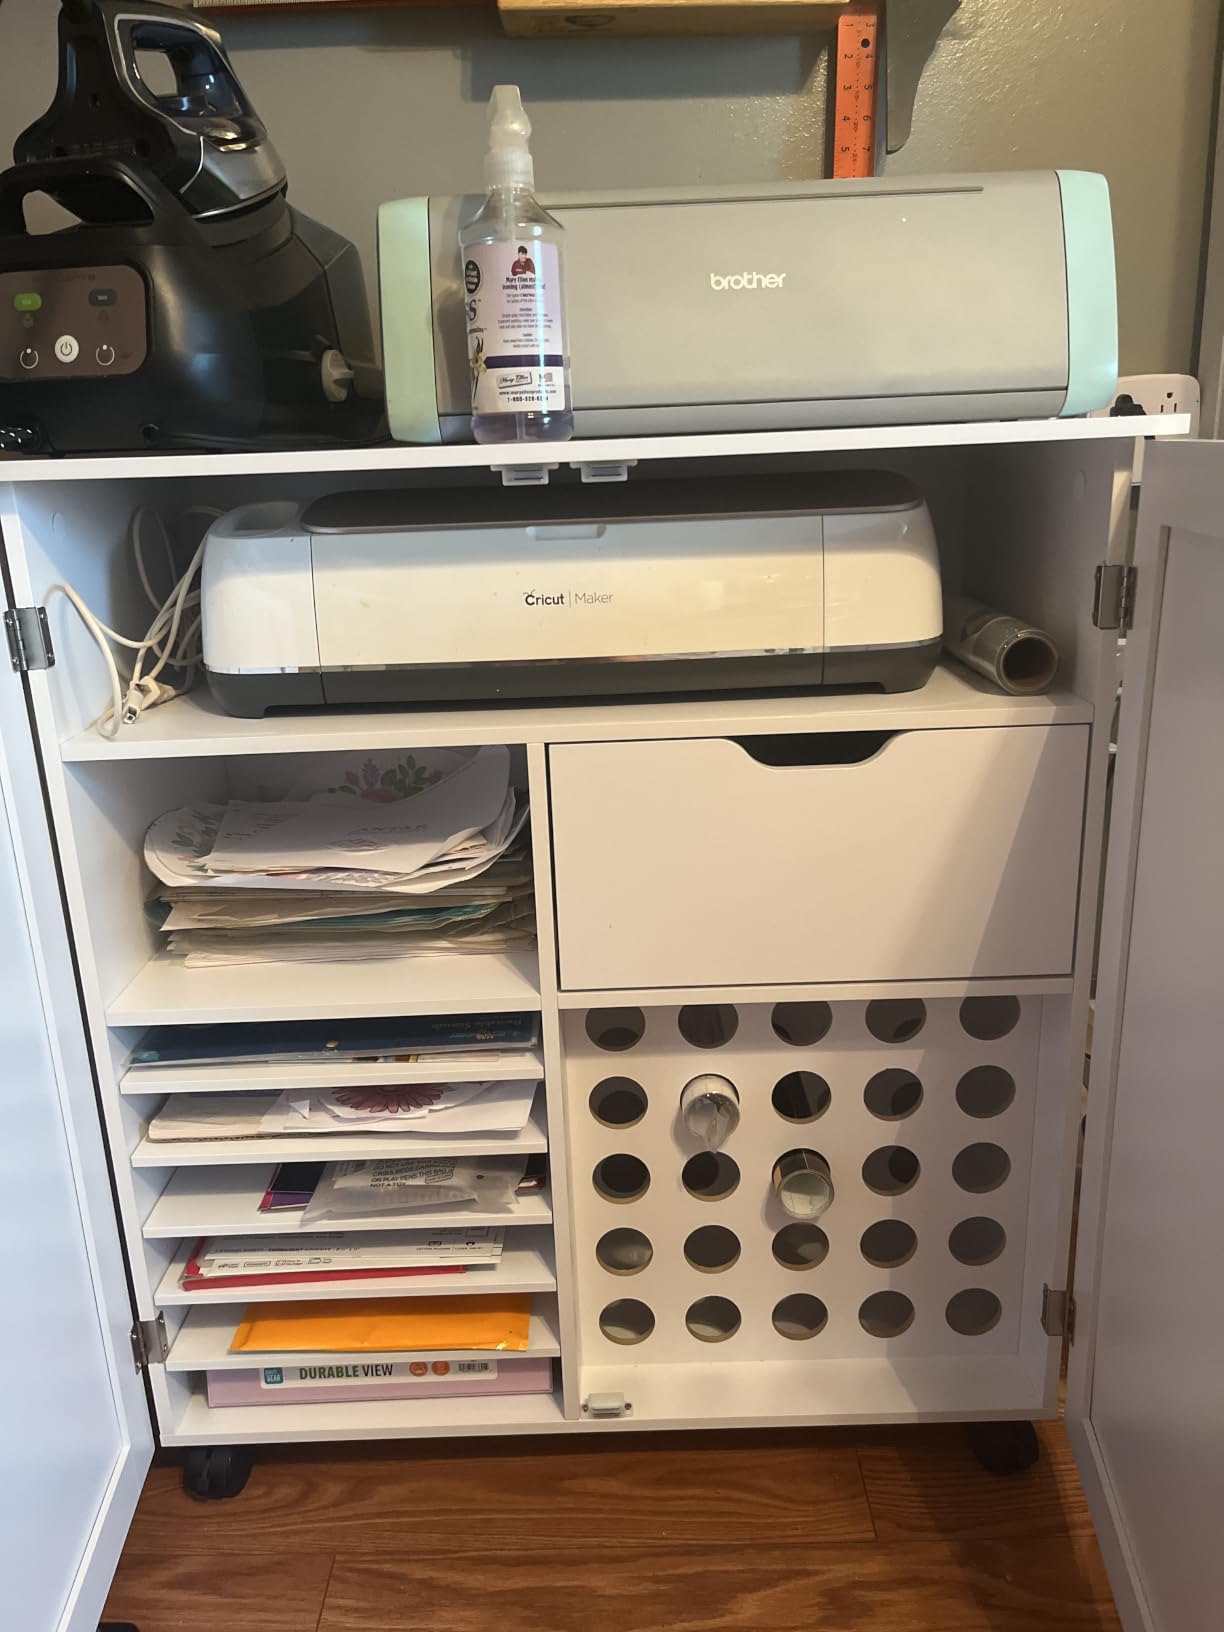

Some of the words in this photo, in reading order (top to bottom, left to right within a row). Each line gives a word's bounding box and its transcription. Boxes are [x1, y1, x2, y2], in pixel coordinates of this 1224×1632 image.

[709, 271, 787, 291] brother
[522, 589, 565, 606] Cricut
[574, 592, 614, 605] Maker
[299, 1365, 360, 1380] DURABLE
[362, 1363, 394, 1377] VIEW
